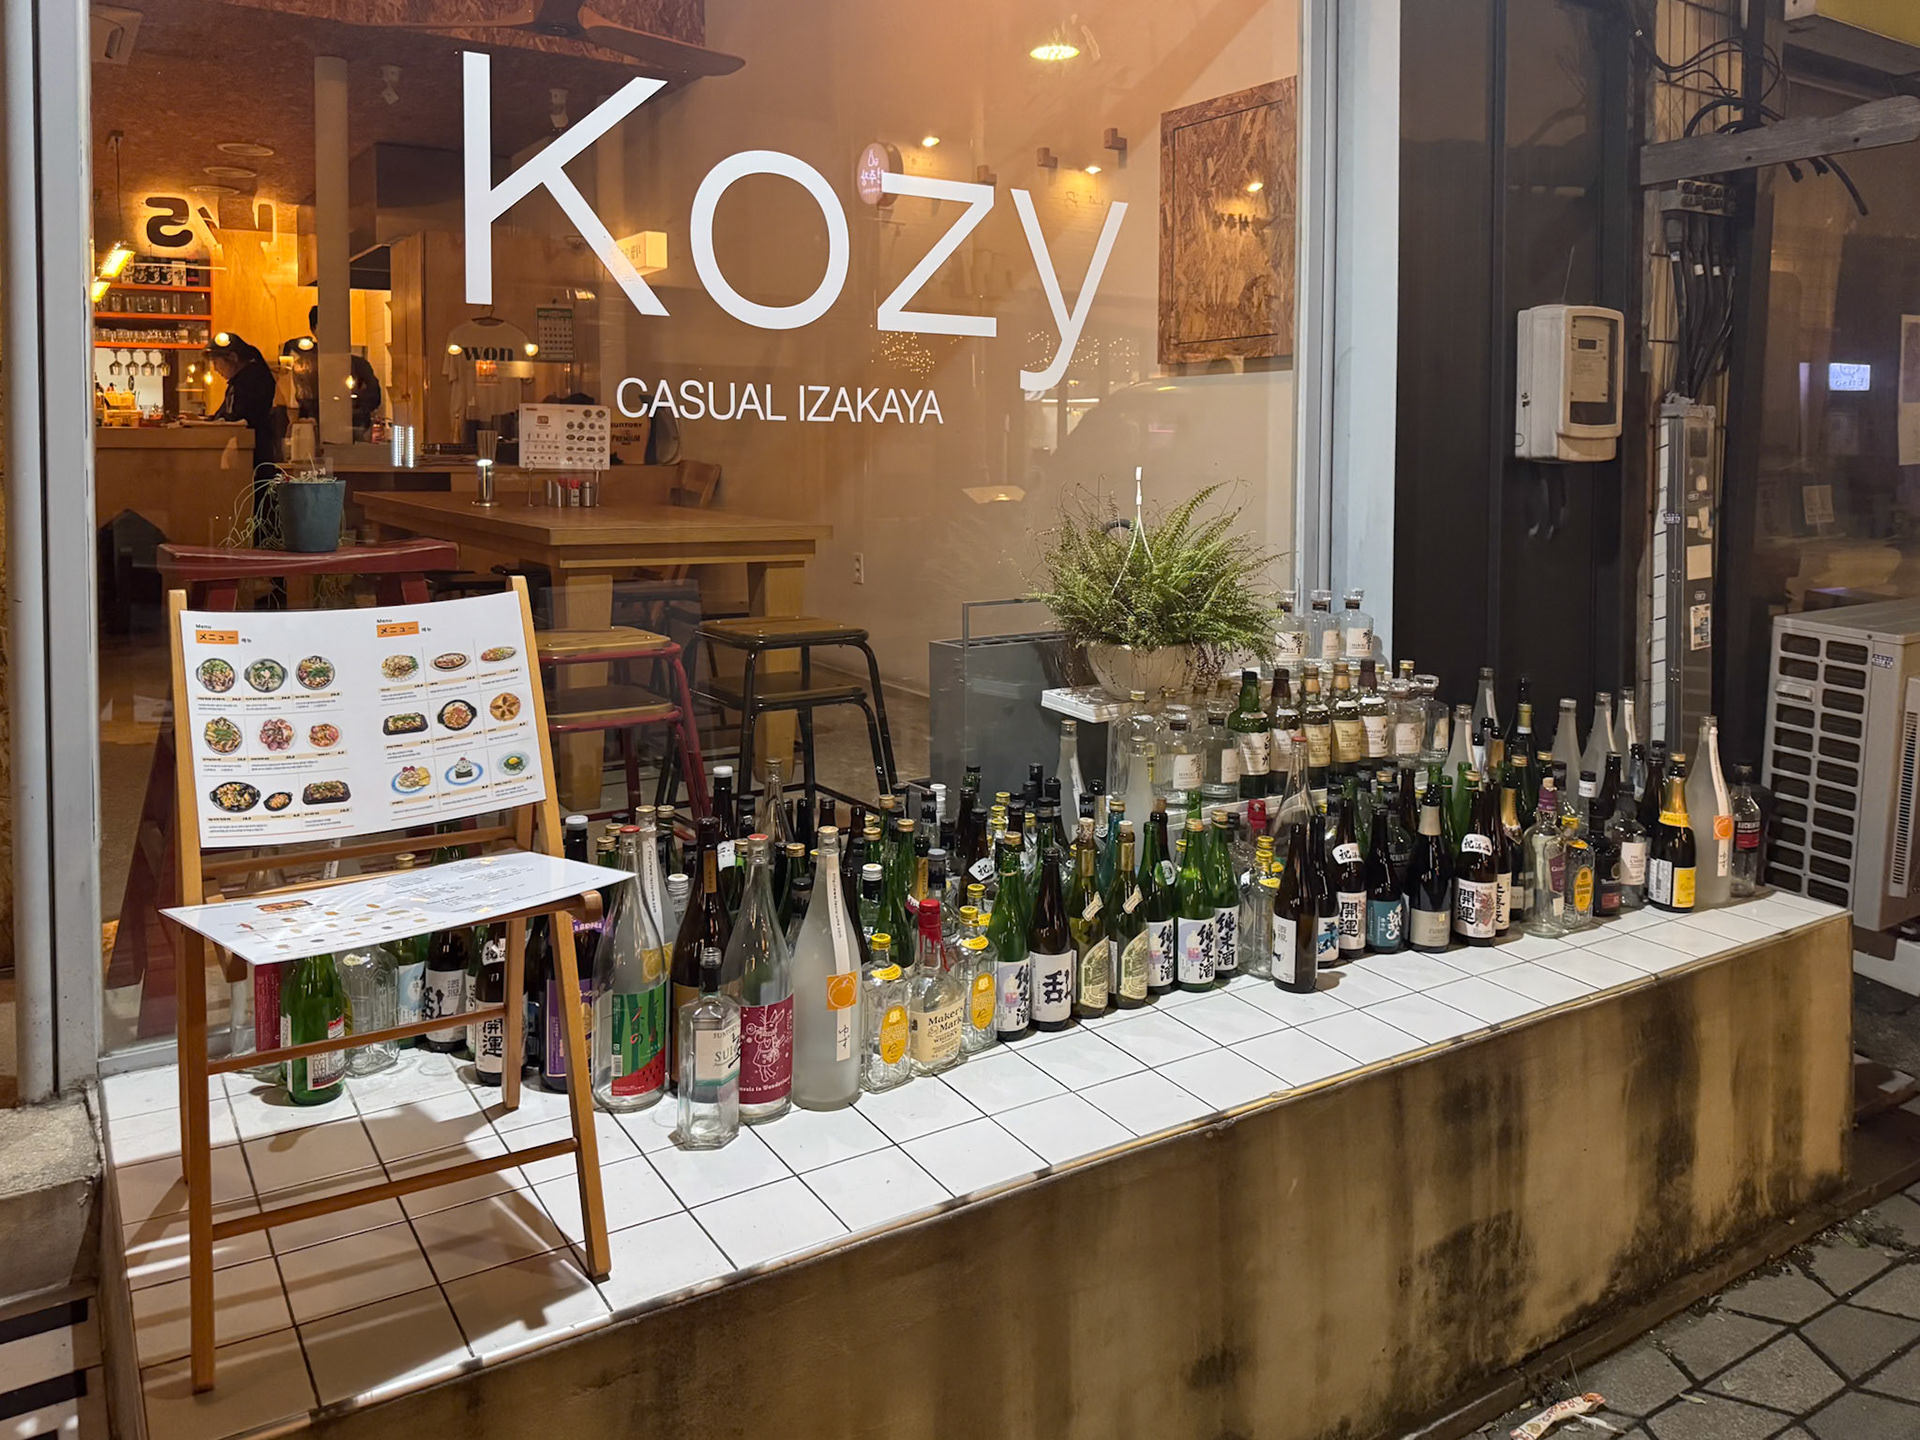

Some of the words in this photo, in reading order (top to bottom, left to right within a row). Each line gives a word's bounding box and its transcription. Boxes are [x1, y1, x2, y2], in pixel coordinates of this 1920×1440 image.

[462, 50, 1129, 394] Kozy
[616, 377, 786, 422] CASUAL
[797, 384, 944, 424] IZAKAYA
[199, 633, 236, 642] メニュー
[380, 626, 416, 635] メニュー
[1338, 902, 1359, 938] 開運
[1457, 889, 1477, 926] 開運
[1158, 924, 1174, 981] 純米酒
[1196, 923, 1215, 980] 純米酒
[1215, 911, 1237, 967] 純米酒
[713, 1025, 738, 1040] SUNTORY
[927, 1005, 965, 1026] Maker's
[939, 1016, 963, 1033] Mark
[482, 1018, 503, 1058] 開運
